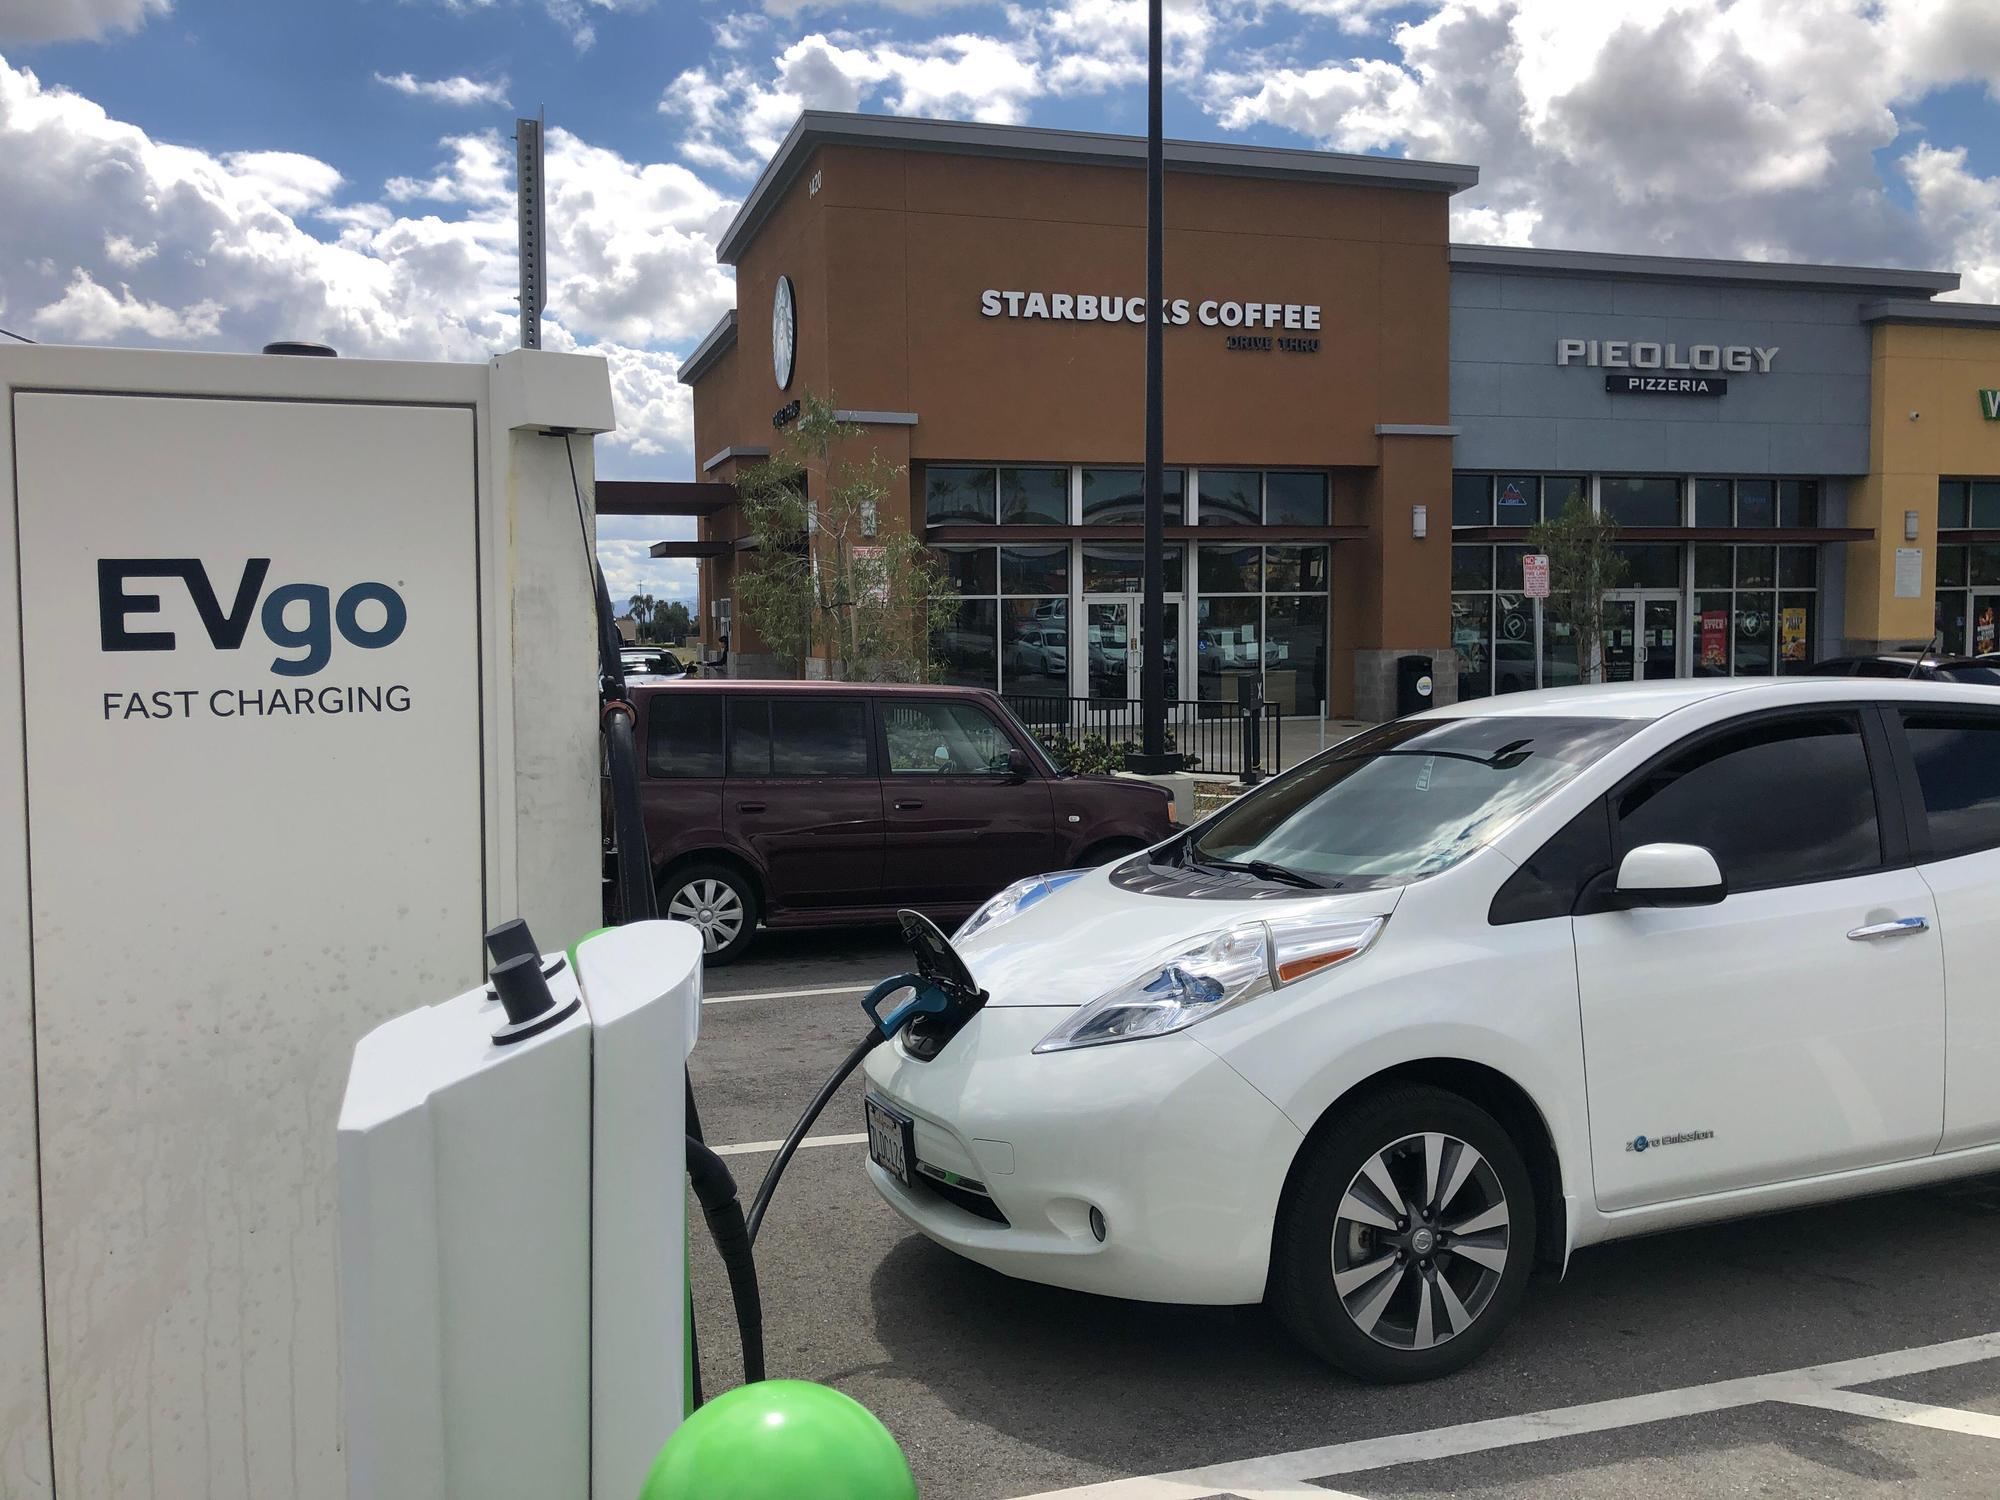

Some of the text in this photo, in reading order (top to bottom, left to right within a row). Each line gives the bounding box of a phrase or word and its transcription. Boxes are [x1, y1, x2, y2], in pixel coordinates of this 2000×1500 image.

[808, 168, 822, 200] 1420
[1197, 300, 1322, 330] COFFEE
[1226, 335, 1320, 352] DRIVE THRU
[1557, 338, 1780, 373] PIEOLOGY
[1628, 378, 1709, 393] PIZZERIA
[1525, 556, 1535, 565] NO
[97, 558, 408, 677] EVgo
[103, 684, 412, 720] FAST CHARGING
